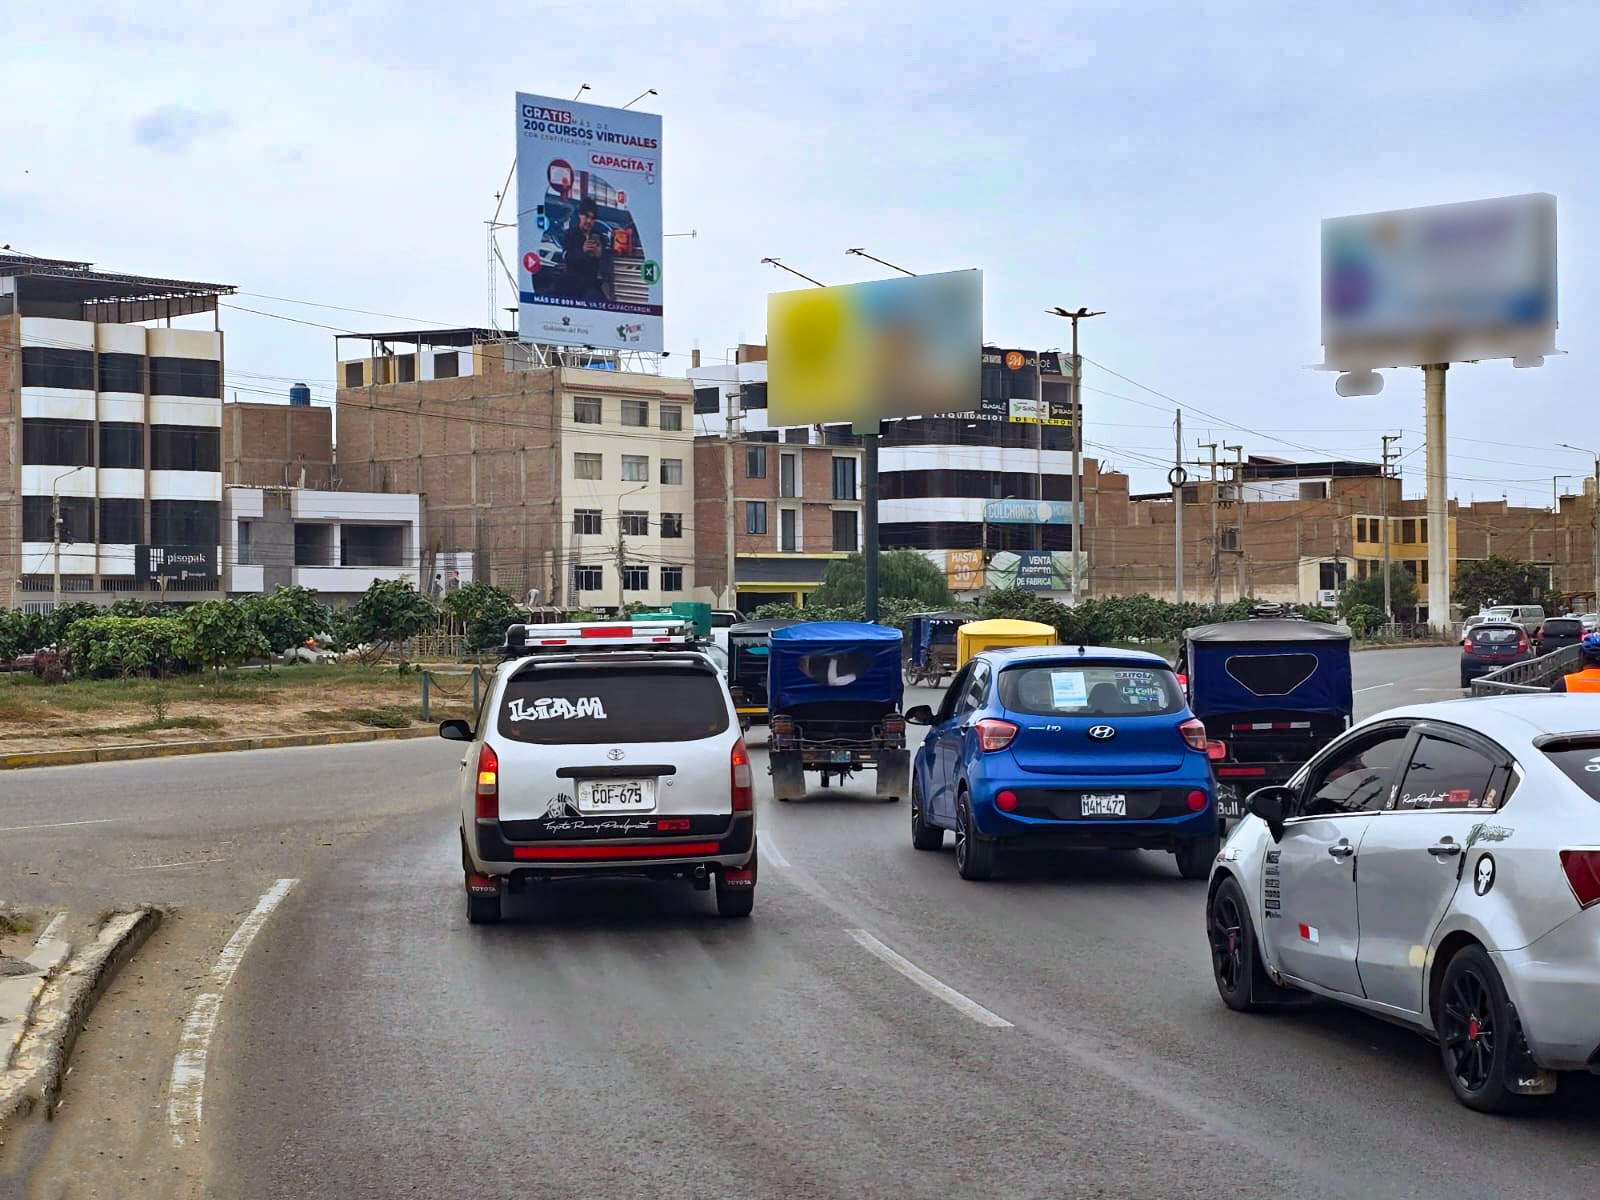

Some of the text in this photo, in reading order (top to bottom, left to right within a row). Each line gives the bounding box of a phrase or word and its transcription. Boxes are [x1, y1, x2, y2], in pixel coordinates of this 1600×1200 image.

[523, 106, 571, 123] GRATIS
[523, 119, 658, 149] 200 CURSOS VIRTUALES
[550, 297, 560, 305] DE
[988, 502, 1036, 519] COLCHONES
[167, 553, 206, 565] pisopak
[951, 552, 978, 564] HASTA
[1028, 555, 1052, 565] VENTA
[1017, 577, 1026, 587] DE
[1217, 801, 1238, 816] Bull
